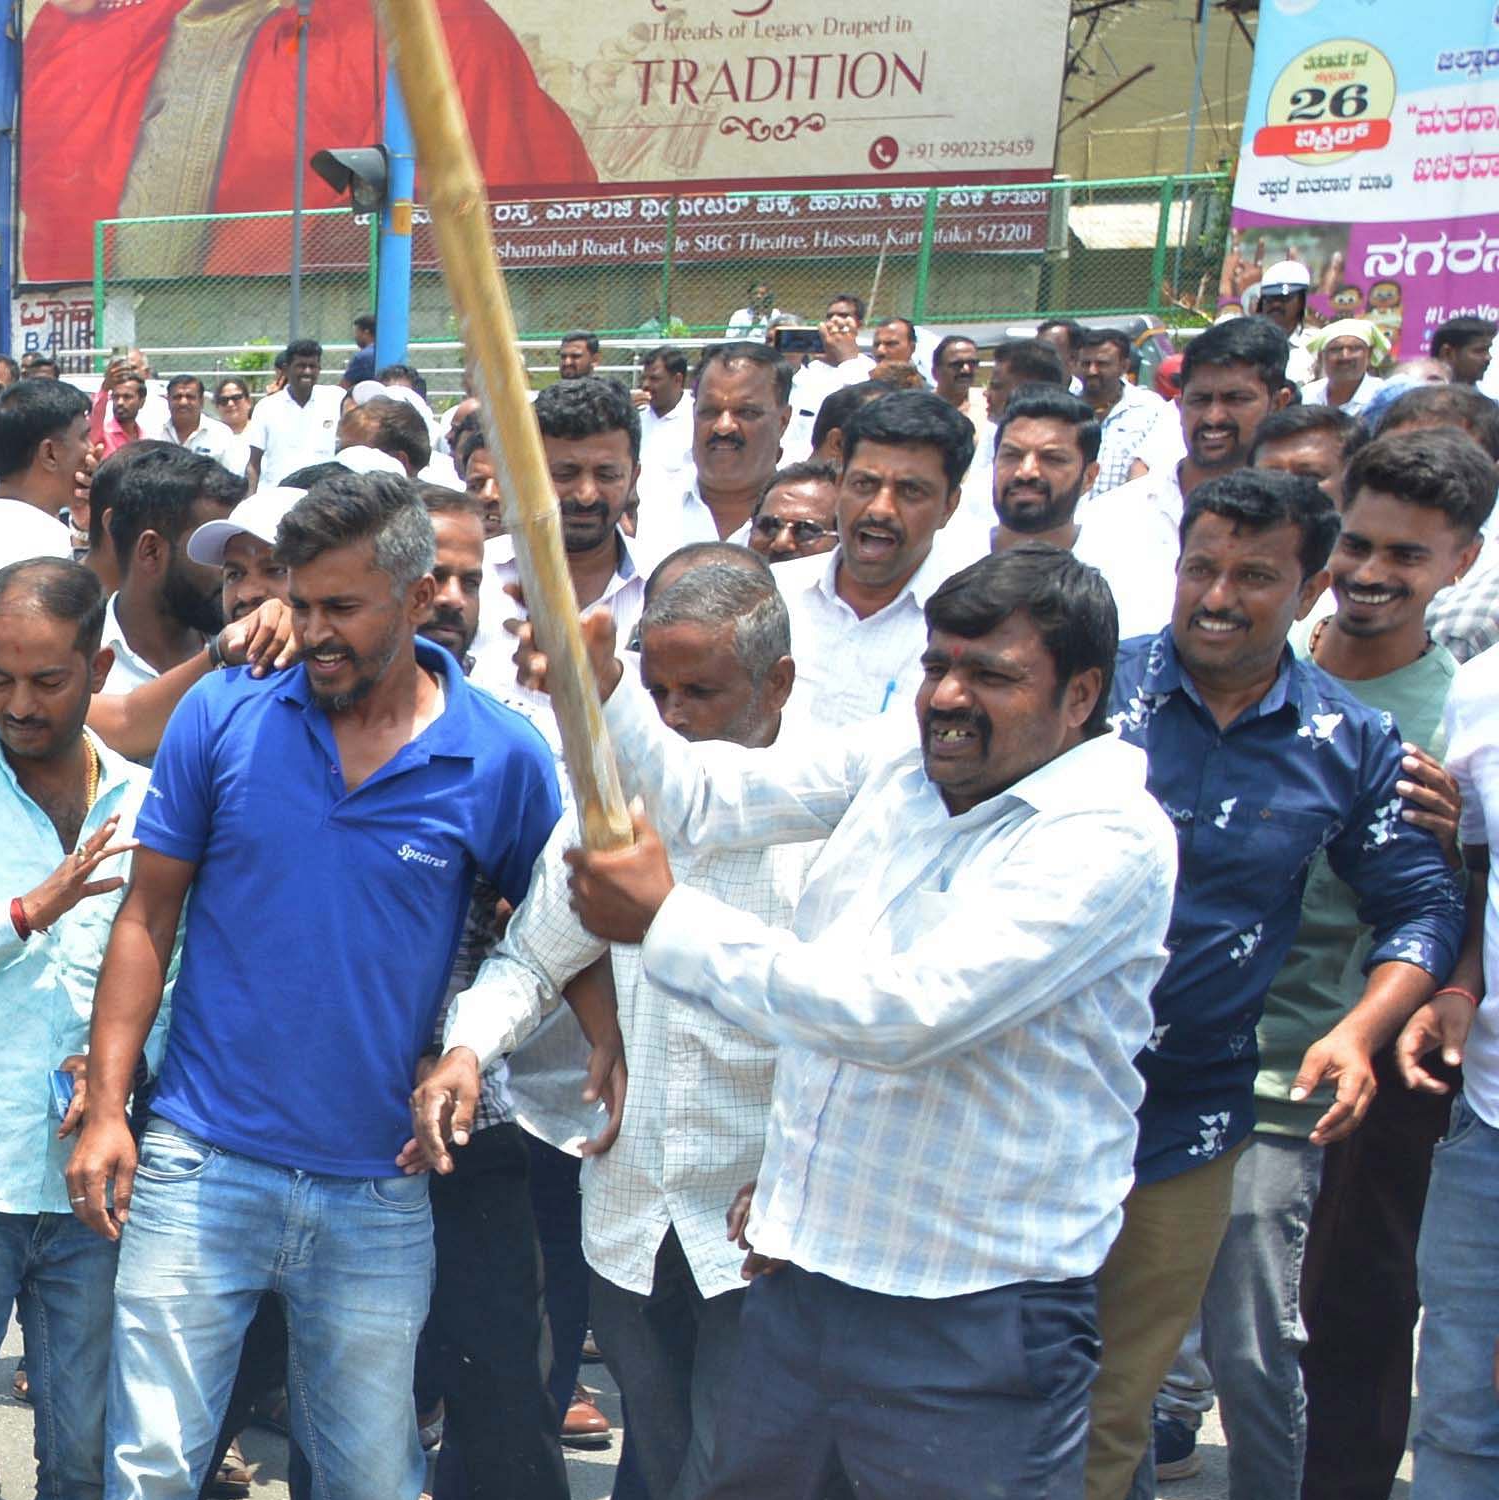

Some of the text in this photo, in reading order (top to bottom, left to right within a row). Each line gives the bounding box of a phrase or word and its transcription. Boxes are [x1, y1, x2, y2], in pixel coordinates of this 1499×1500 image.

[652, 16, 913, 41] Threads of Legacy Draped in
[632, 50, 928, 106] TRADITION
[1288, 84, 1369, 122] 26
[1295, 122, 1371, 152] ಏಪ್ರಿಲ್
[1296, 174, 1351, 194] ಮತದಾನ
[978, 223, 1033, 243] 573201
